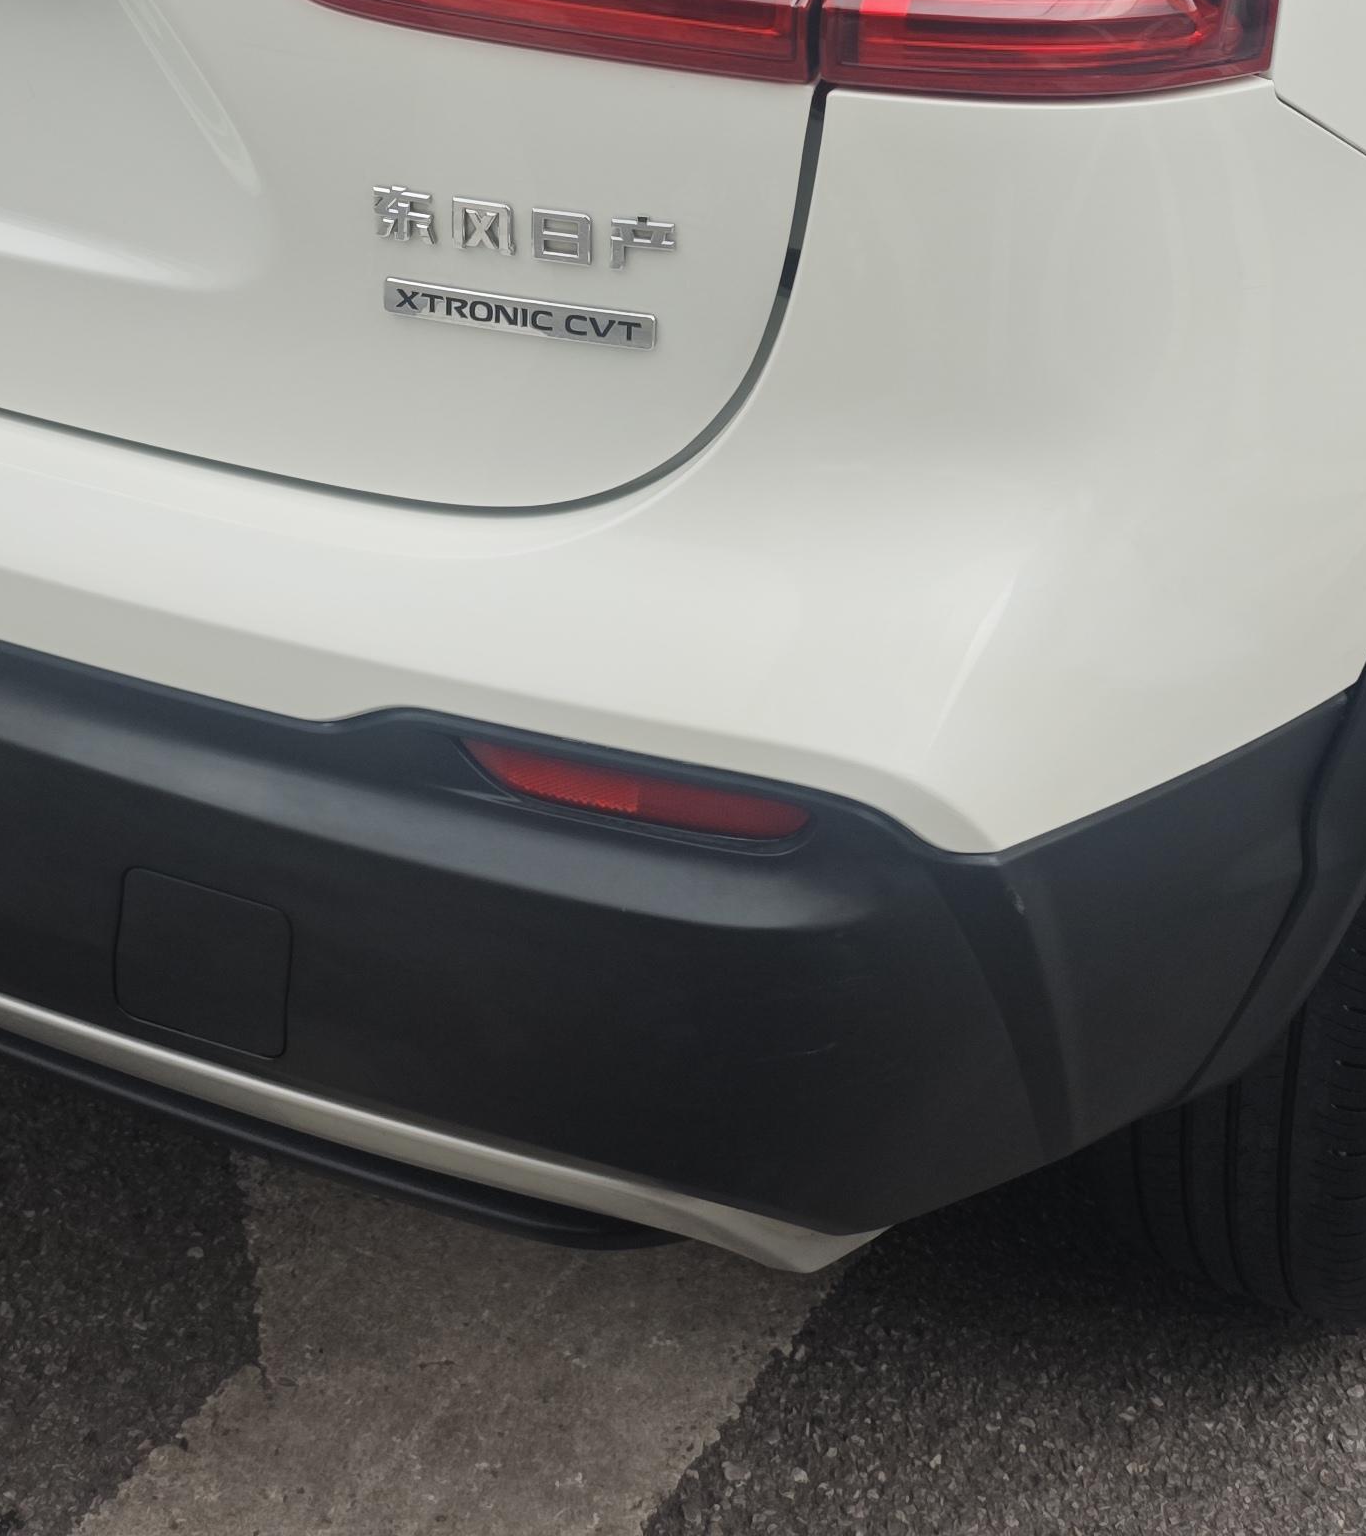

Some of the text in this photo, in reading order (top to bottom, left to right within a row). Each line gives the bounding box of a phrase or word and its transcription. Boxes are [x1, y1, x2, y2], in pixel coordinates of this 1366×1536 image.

[372, 183, 677, 270] 东风日产
[395, 287, 642, 342] XTRONIC CVT
